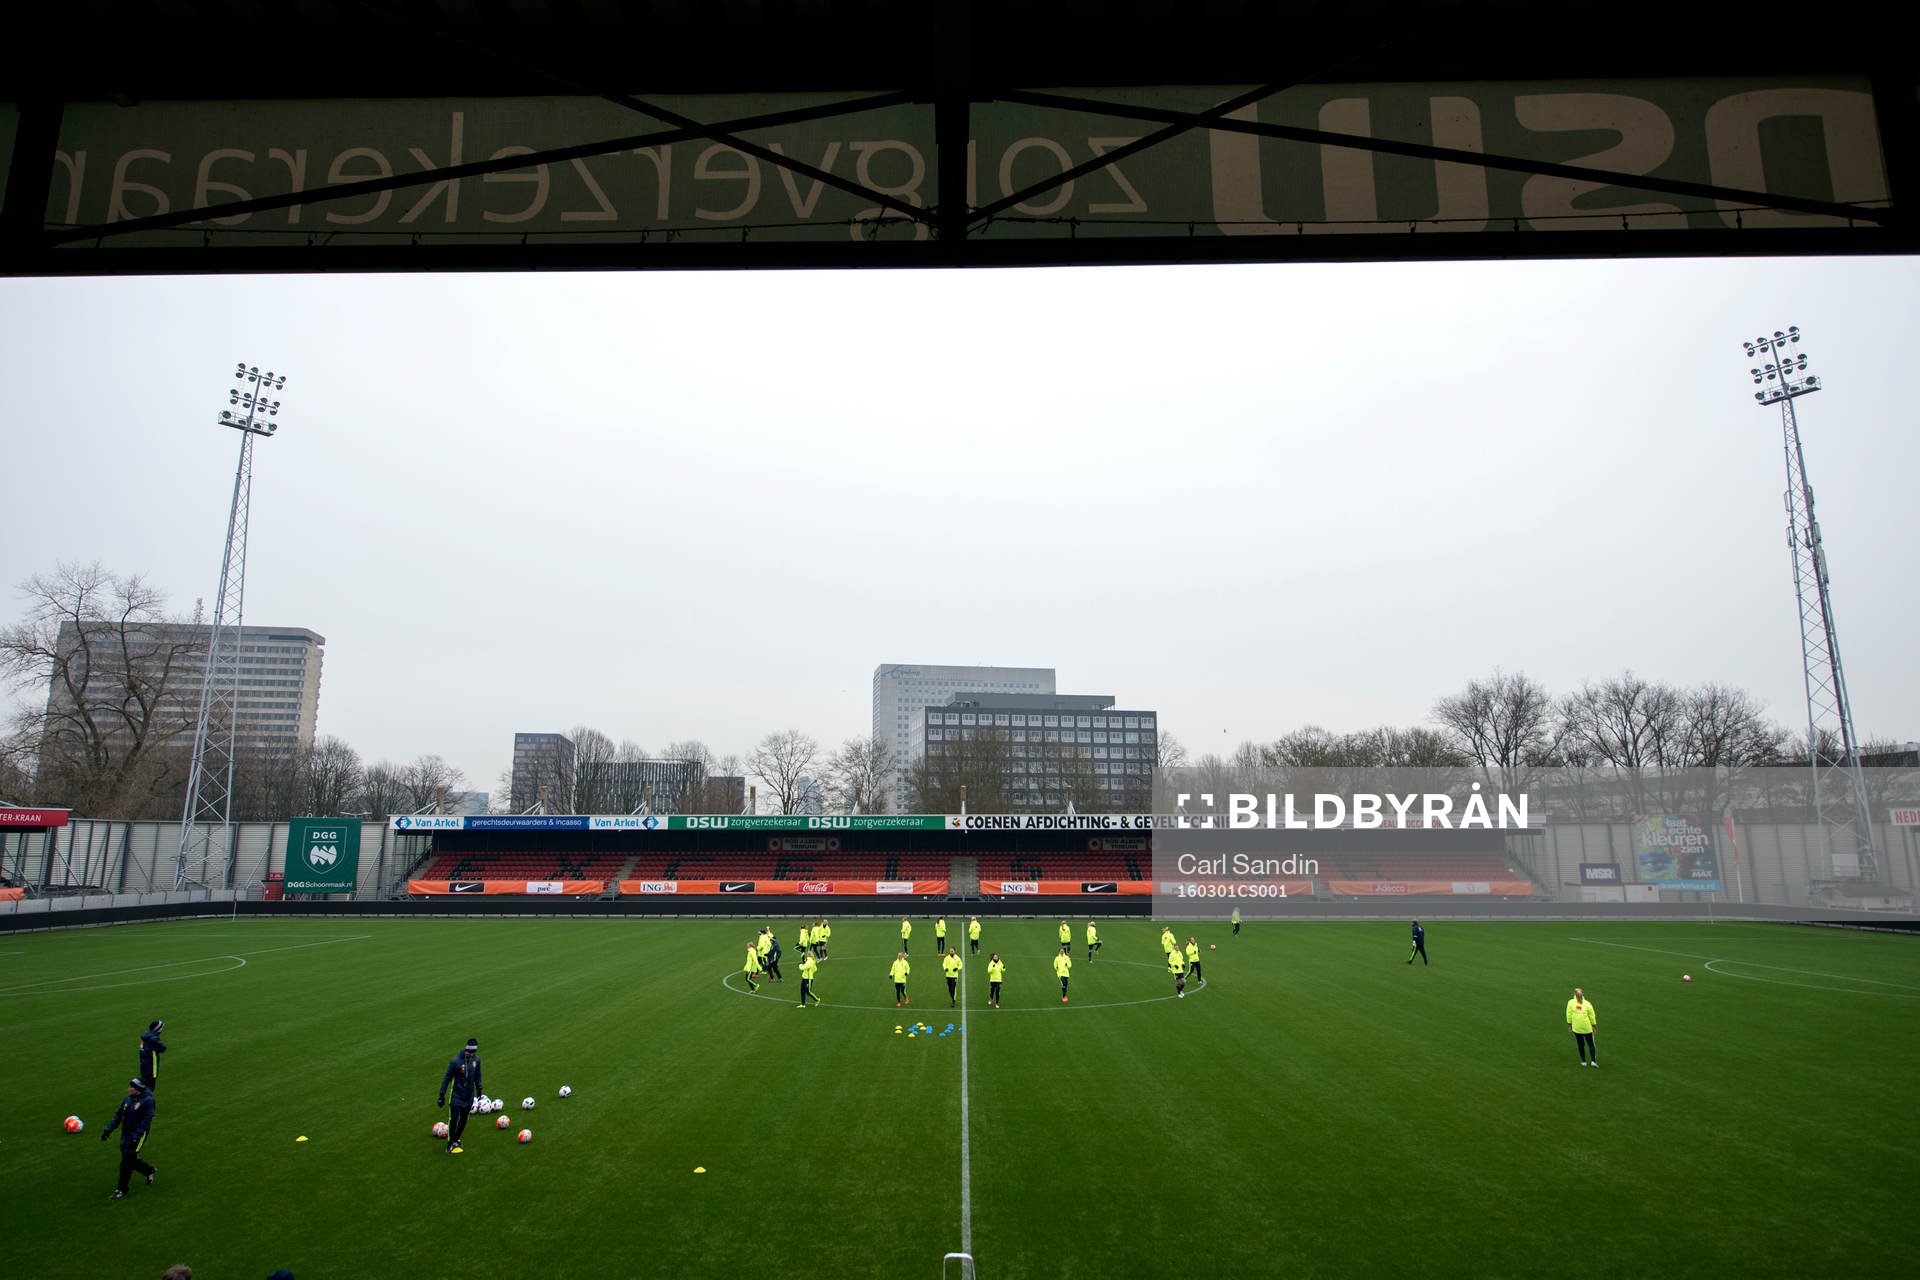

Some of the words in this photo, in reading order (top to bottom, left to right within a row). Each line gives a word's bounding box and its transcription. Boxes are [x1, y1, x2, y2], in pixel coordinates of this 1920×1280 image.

[415, 818, 432, 827] Van
[434, 818, 459, 827] Arkel
[472, 819, 547, 827] gerechtsdeurwaarders
[594, 818, 612, 827] Van
[614, 818, 639, 827] Arkel
[686, 817, 729, 829] DSW
[731, 818, 802, 829] zorgverzekeraar
[808, 817, 851, 829] DSW
[853, 818, 925, 829] zorgverzekeraar
[965, 816, 1021, 829] COENEN
[1120, 816, 1129, 829] &
[1134, 816, 1243, 829] GEVELCHNI
[1669, 826, 1701, 835] echte
[1680, 844, 1704, 853] zien
[1692, 870, 1712, 878] MAX
[642, 884, 662, 892] ING
[1003, 884, 1023, 892] ING
[1376, 884, 1405, 893] Adecco
